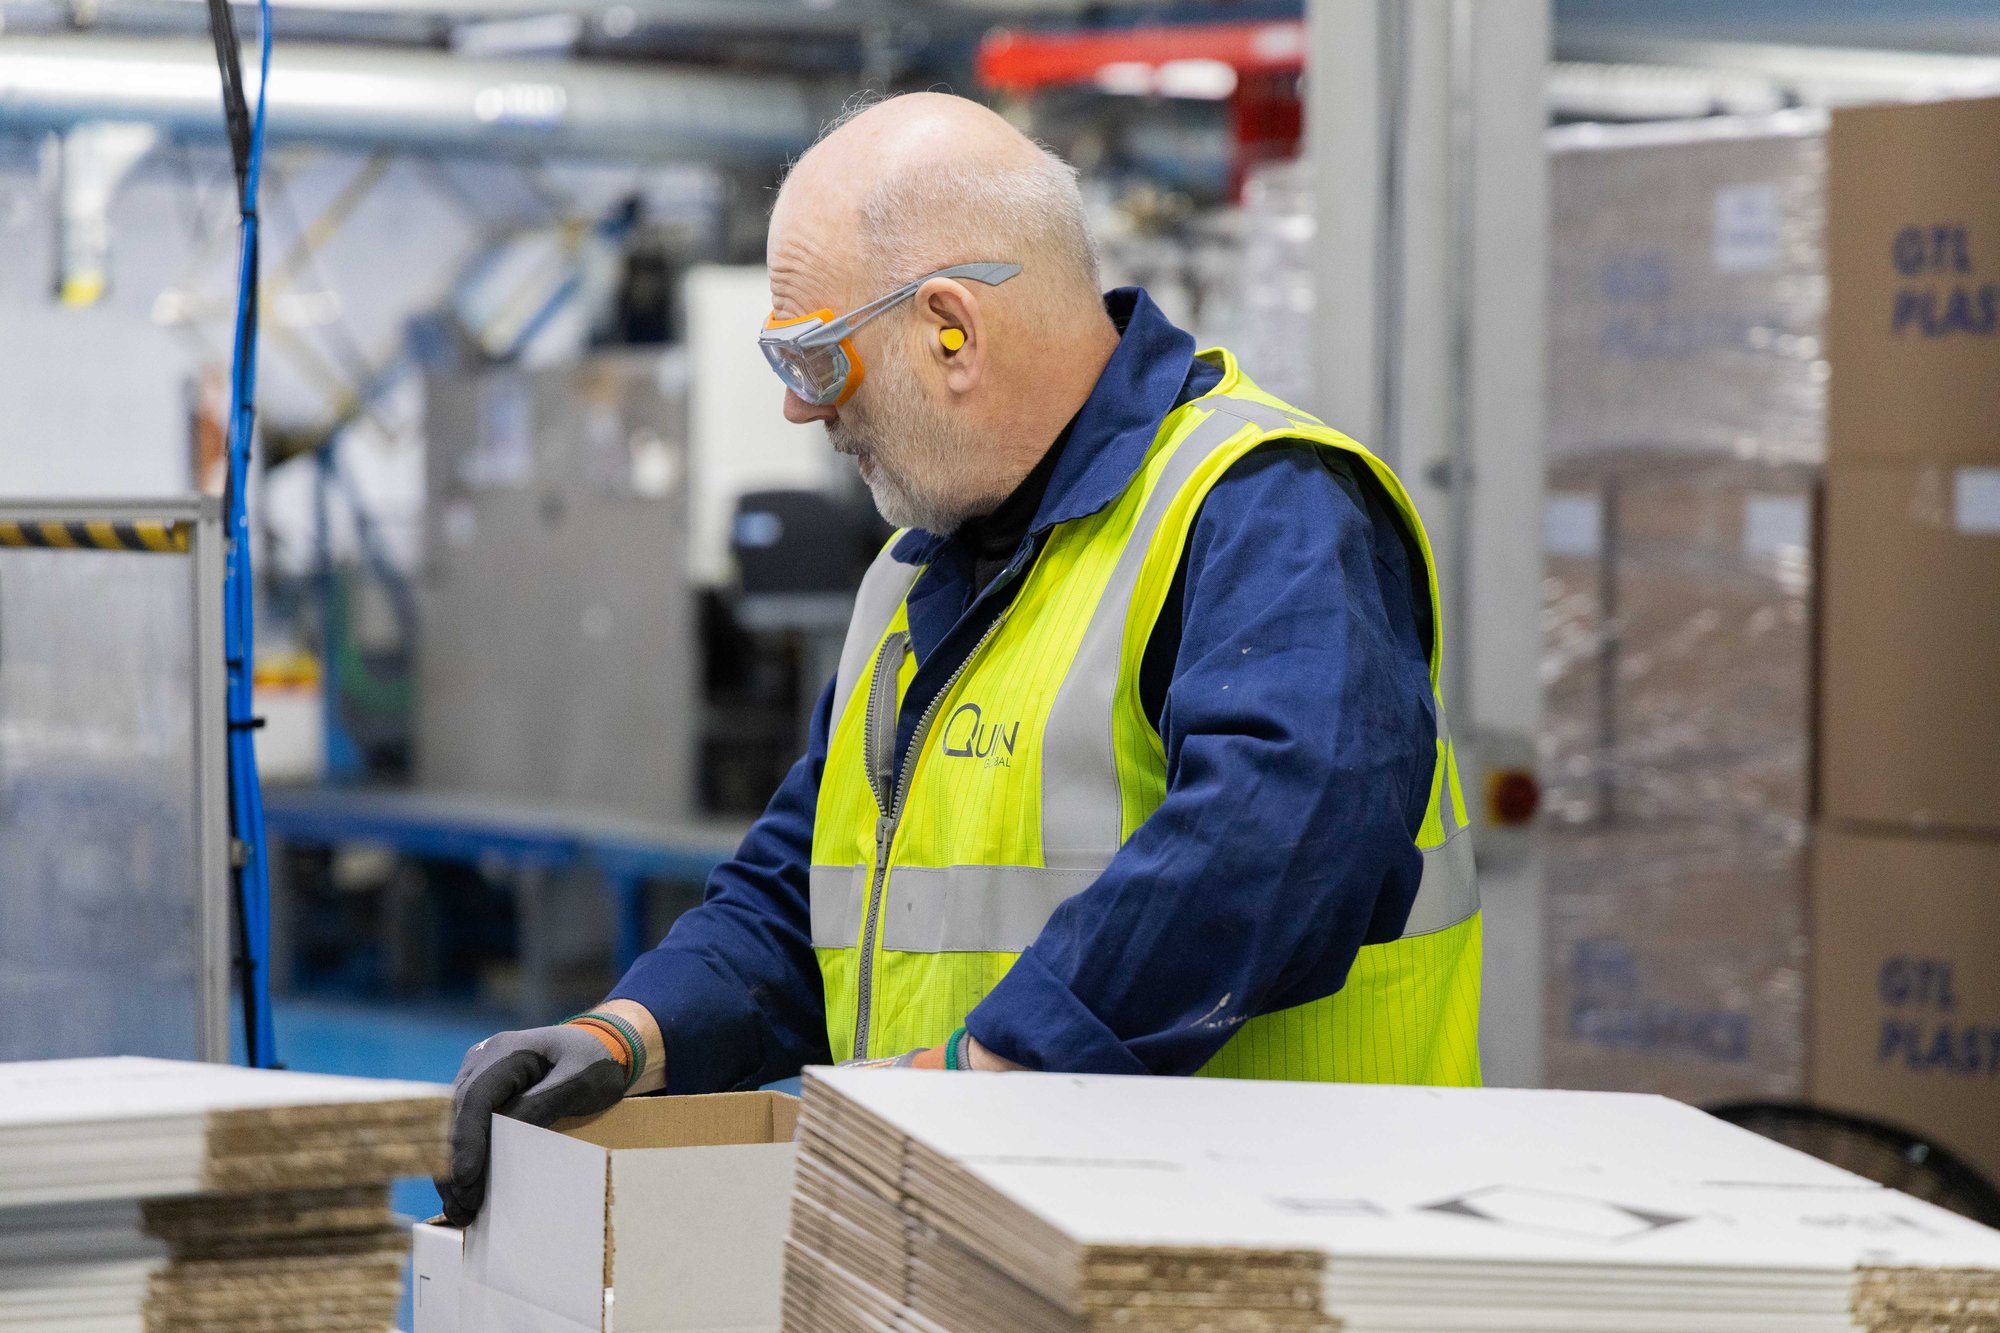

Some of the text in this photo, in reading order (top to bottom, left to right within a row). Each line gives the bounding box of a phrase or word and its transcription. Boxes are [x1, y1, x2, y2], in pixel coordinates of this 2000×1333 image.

[1891, 225, 1971, 276] GTL
[943, 703, 1020, 758] QUIN
[1878, 957, 1957, 1011] GTL
